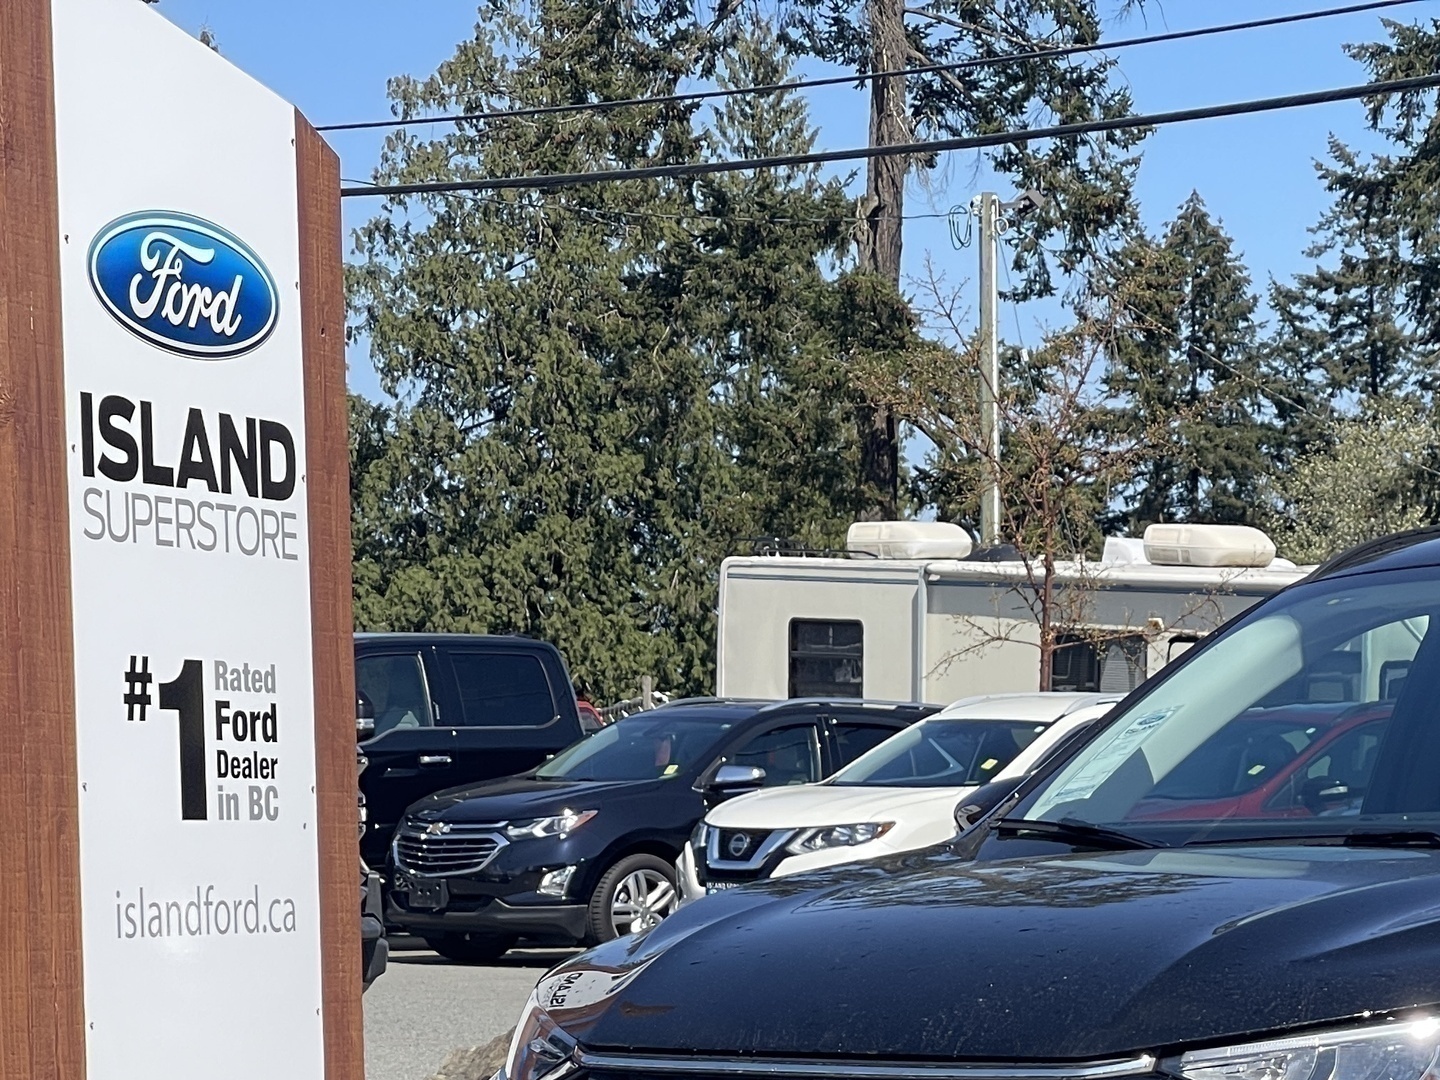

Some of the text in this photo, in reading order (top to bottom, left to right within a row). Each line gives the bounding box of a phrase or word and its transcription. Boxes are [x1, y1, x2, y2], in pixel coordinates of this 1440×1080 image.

[129, 231, 243, 336] Ford
[79, 391, 296, 501] ISLAND
[83, 487, 299, 561] SUPERSTORE
[213, 660, 277, 694] Rated
[123, 655, 208, 821] #1
[215, 700, 278, 743] Ford
[216, 749, 278, 780] Dealer
[217, 785, 279, 822] in BC
[115, 884, 297, 939] islandford.ca
